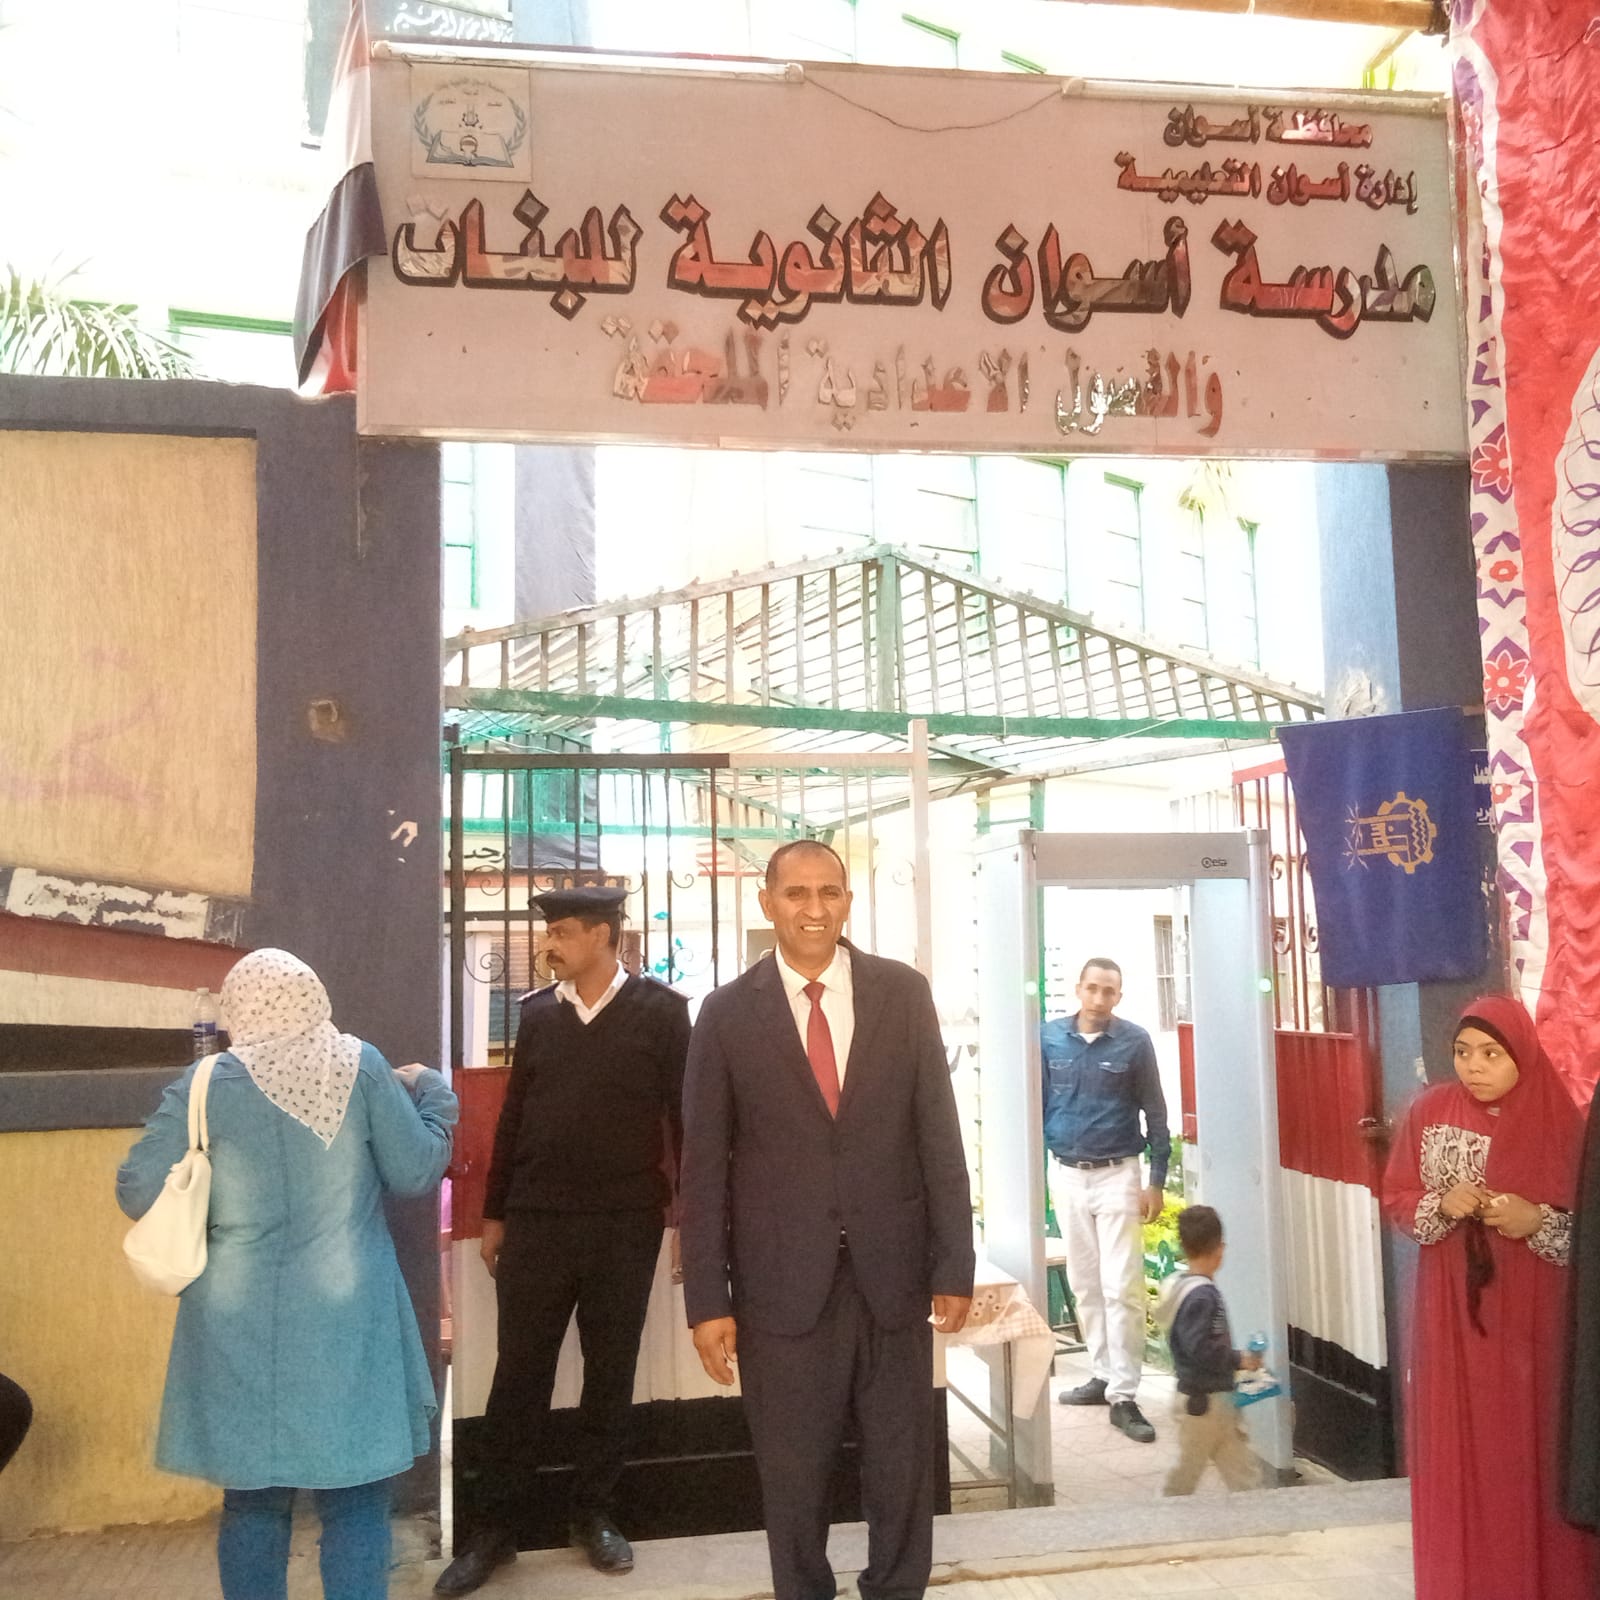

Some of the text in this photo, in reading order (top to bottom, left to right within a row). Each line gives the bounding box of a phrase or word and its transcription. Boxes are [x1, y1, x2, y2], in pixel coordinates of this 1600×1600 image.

[1163, 103, 1373, 148] محافظة أسوان
[1114, 151, 1418, 215] إدارة أسوان التعليمية
[392, 188, 1436, 339] مدرسة أسوان الثانوية للبنات
[1055, 347, 1224, 438] والفصول
